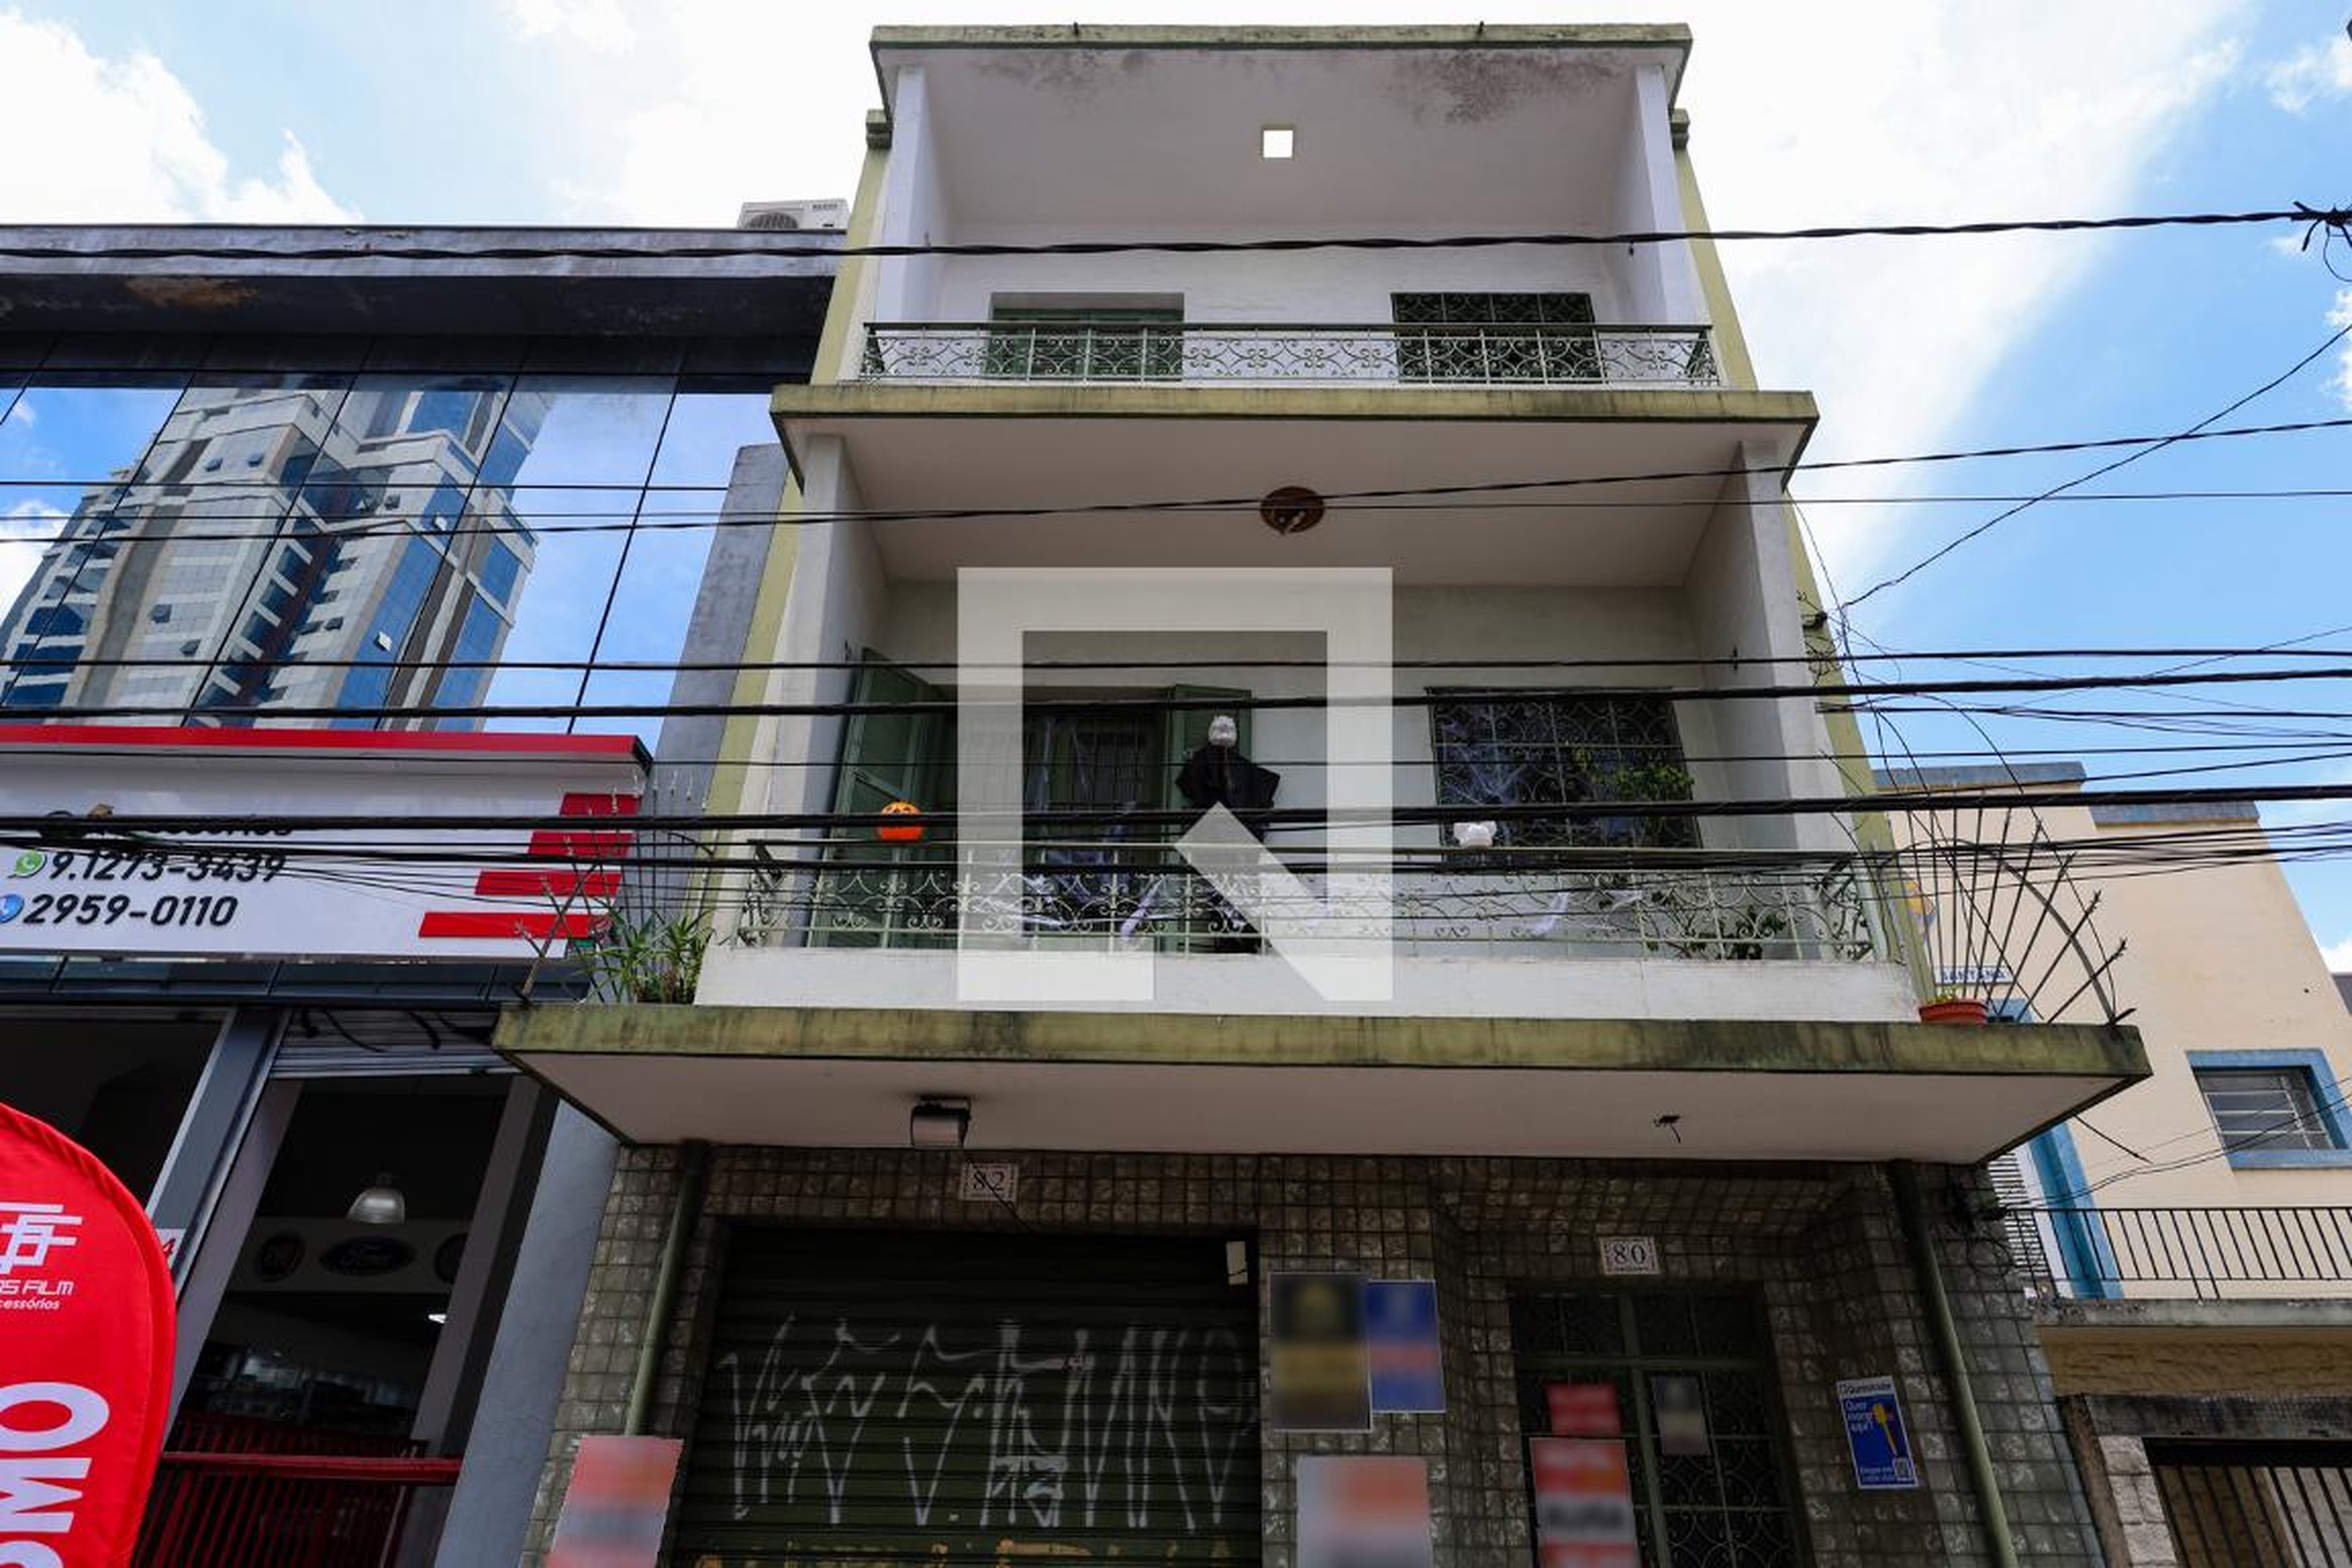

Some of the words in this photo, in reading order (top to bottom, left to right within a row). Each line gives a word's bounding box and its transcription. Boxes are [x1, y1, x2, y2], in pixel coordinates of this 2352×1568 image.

[50, 850, 287, 882] 9.1273-3439
[23, 893, 239, 927] 2959-0110
[973, 1170, 1005, 1191] 82
[1613, 1244, 1646, 1264] 80
